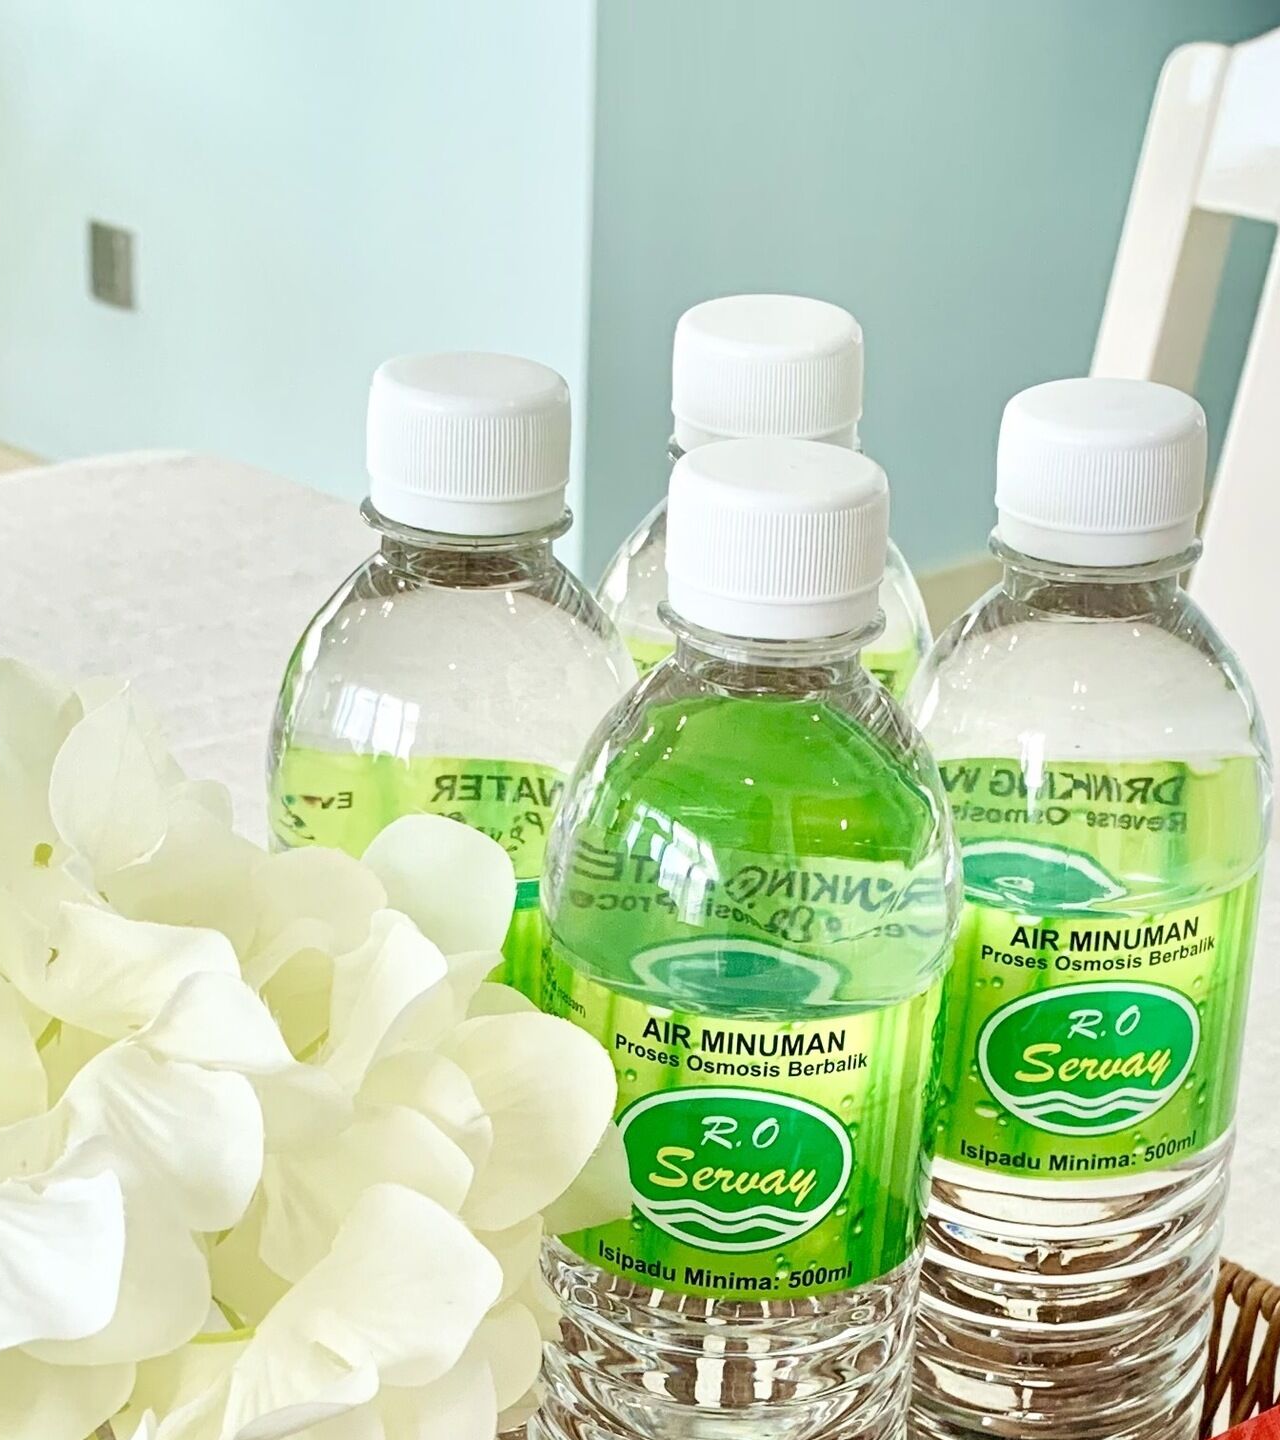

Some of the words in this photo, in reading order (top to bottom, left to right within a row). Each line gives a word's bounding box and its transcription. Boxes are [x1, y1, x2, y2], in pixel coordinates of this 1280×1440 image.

[980, 944, 1049, 971] Proses
[1054, 955, 1143, 972] Osmosis
[1148, 935, 1216, 967] Berbalik
[1009, 926, 1060, 951] AIR
[1069, 916, 1200, 953] MINUMAN
[615, 1033, 680, 1068] Proses
[687, 1054, 781, 1078] Osmosis
[788, 1052, 869, 1078] Berbalik
[642, 1018, 691, 1049] AIR
[700, 1028, 847, 1058] MINUMAN
[1014, 1042, 1172, 1086] Servay
[960, 1138, 1041, 1171] Isipadu
[1048, 1153, 1137, 1172] Minima:
[1143, 1131, 1197, 1162] 500ml
[648, 1145, 818, 1207] Servay
[598, 1239, 677, 1283] Isipadu
[684, 1267, 780, 1291] Minima:
[788, 1261, 853, 1289] 500ml
